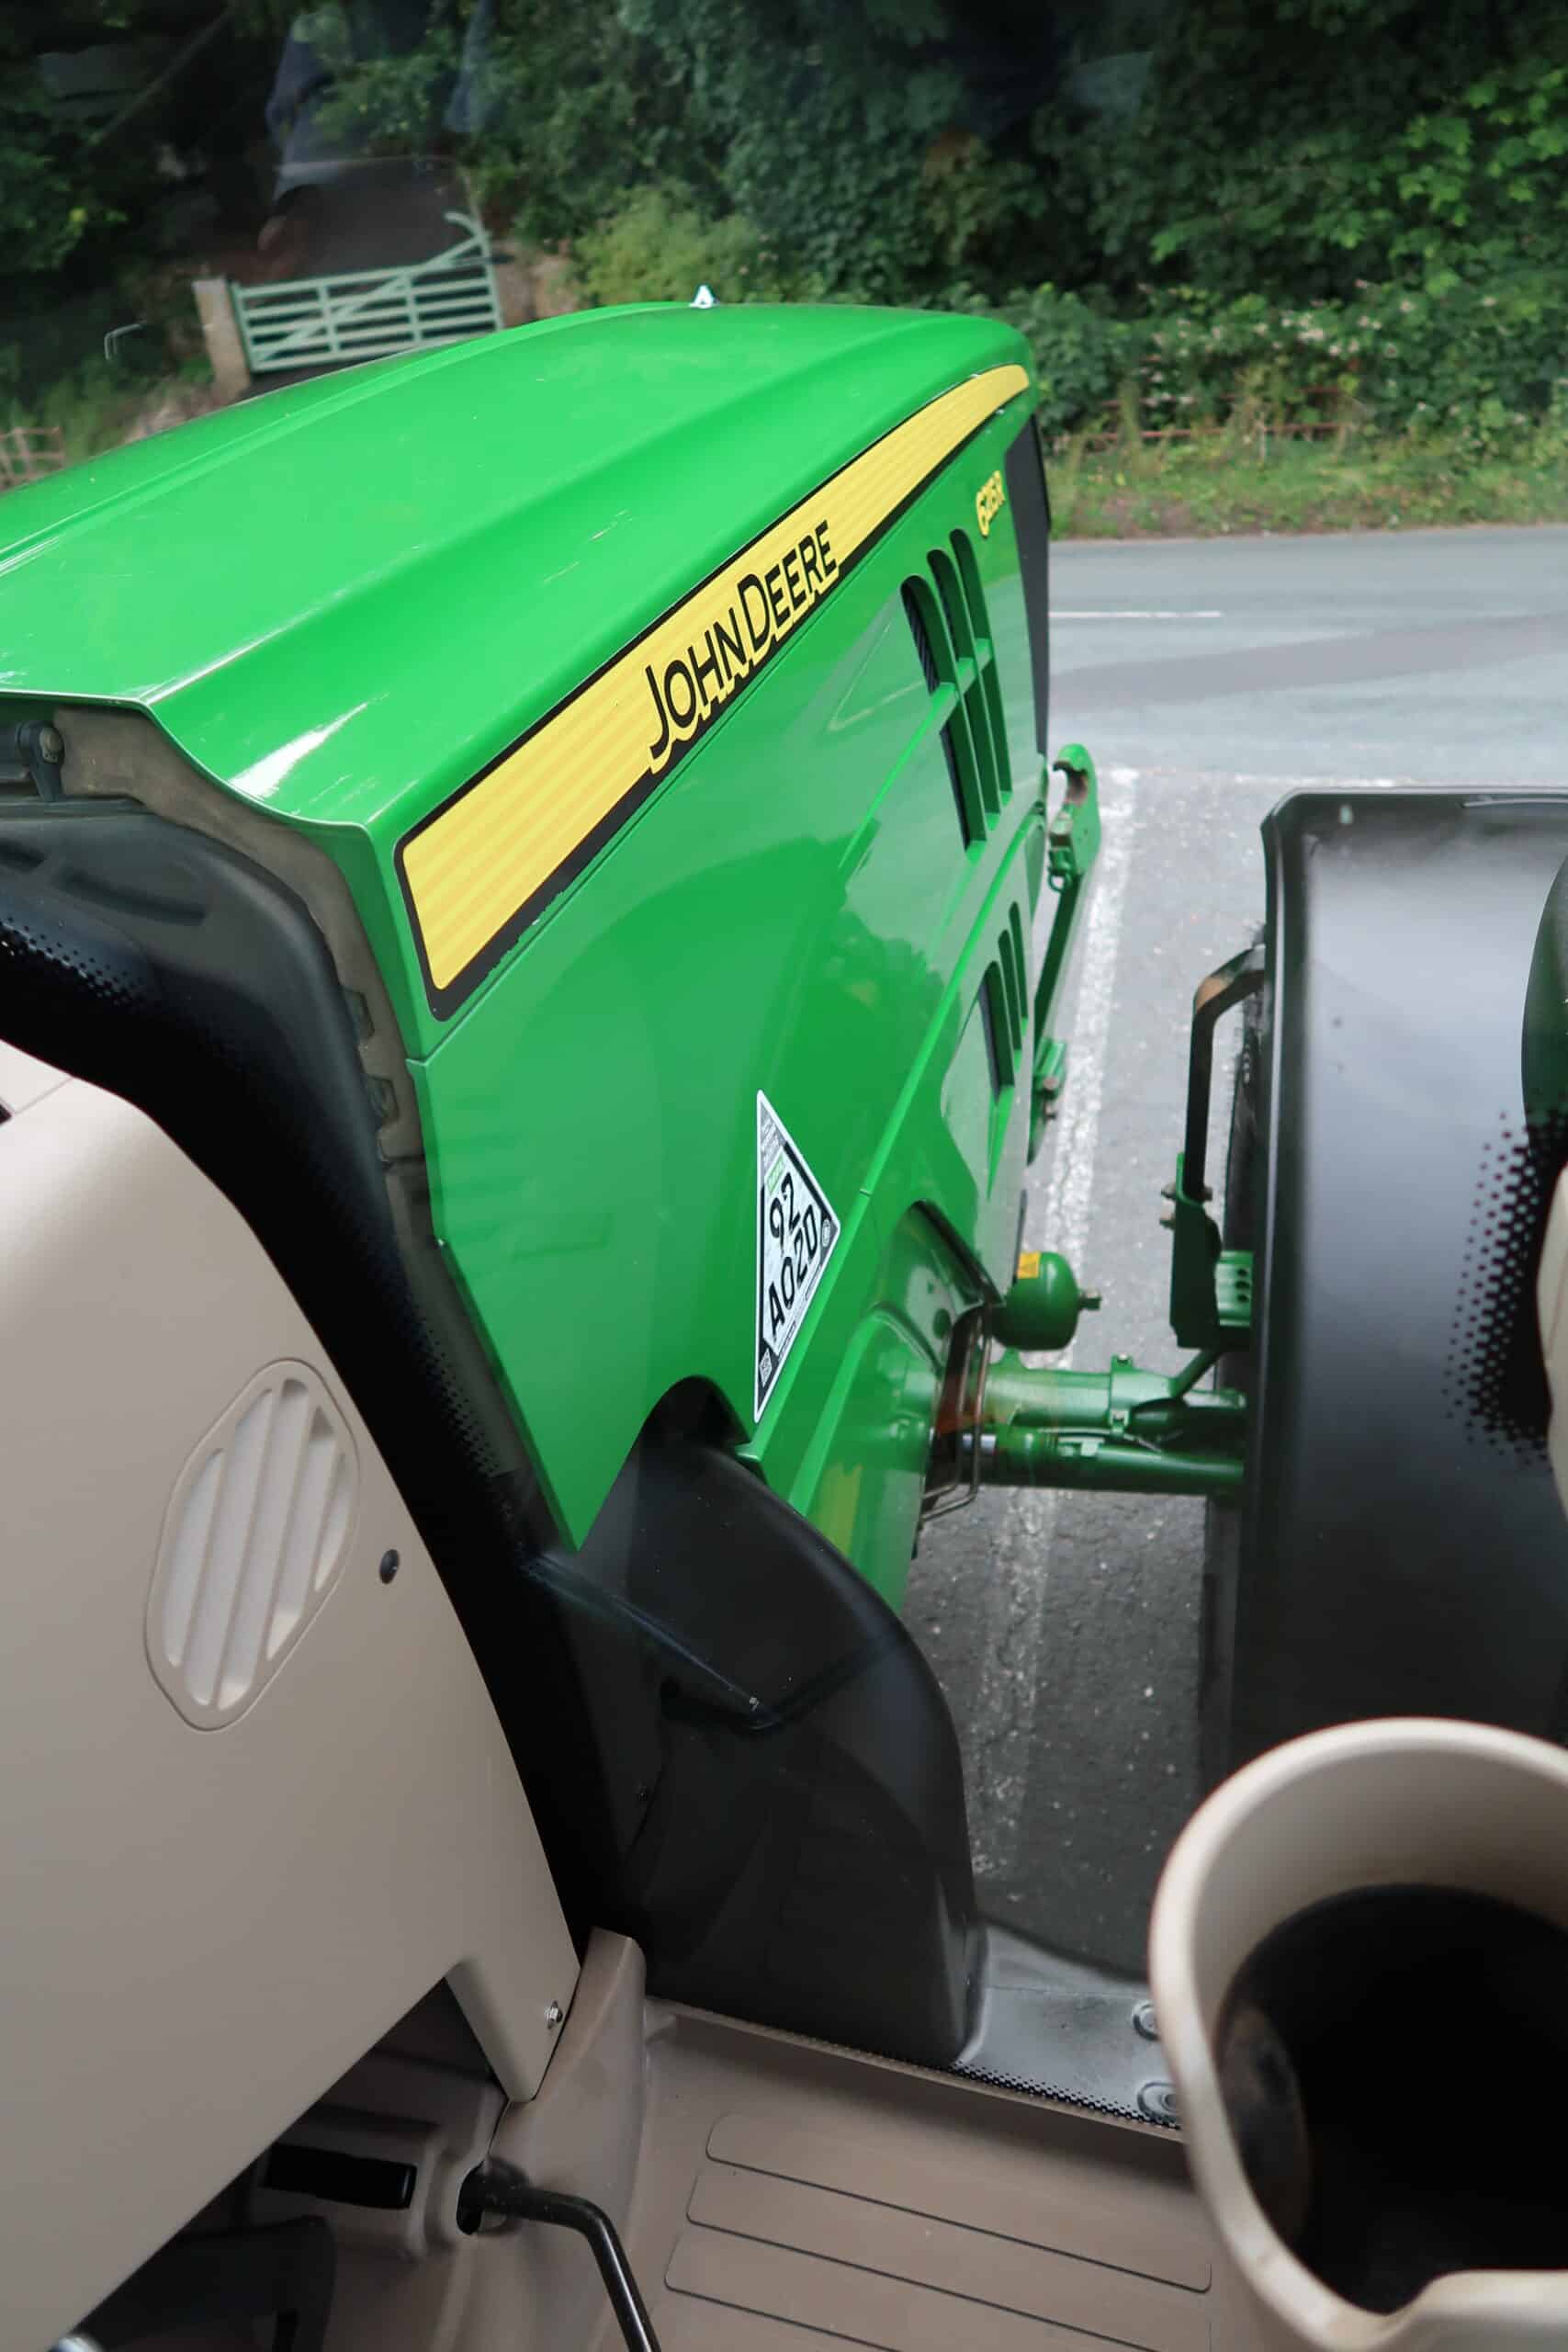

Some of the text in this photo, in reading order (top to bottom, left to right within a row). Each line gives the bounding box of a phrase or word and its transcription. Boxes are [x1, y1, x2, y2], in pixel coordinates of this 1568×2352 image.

[645, 519, 837, 760] JOHN DEERE
[770, 1171, 801, 1252] 92
